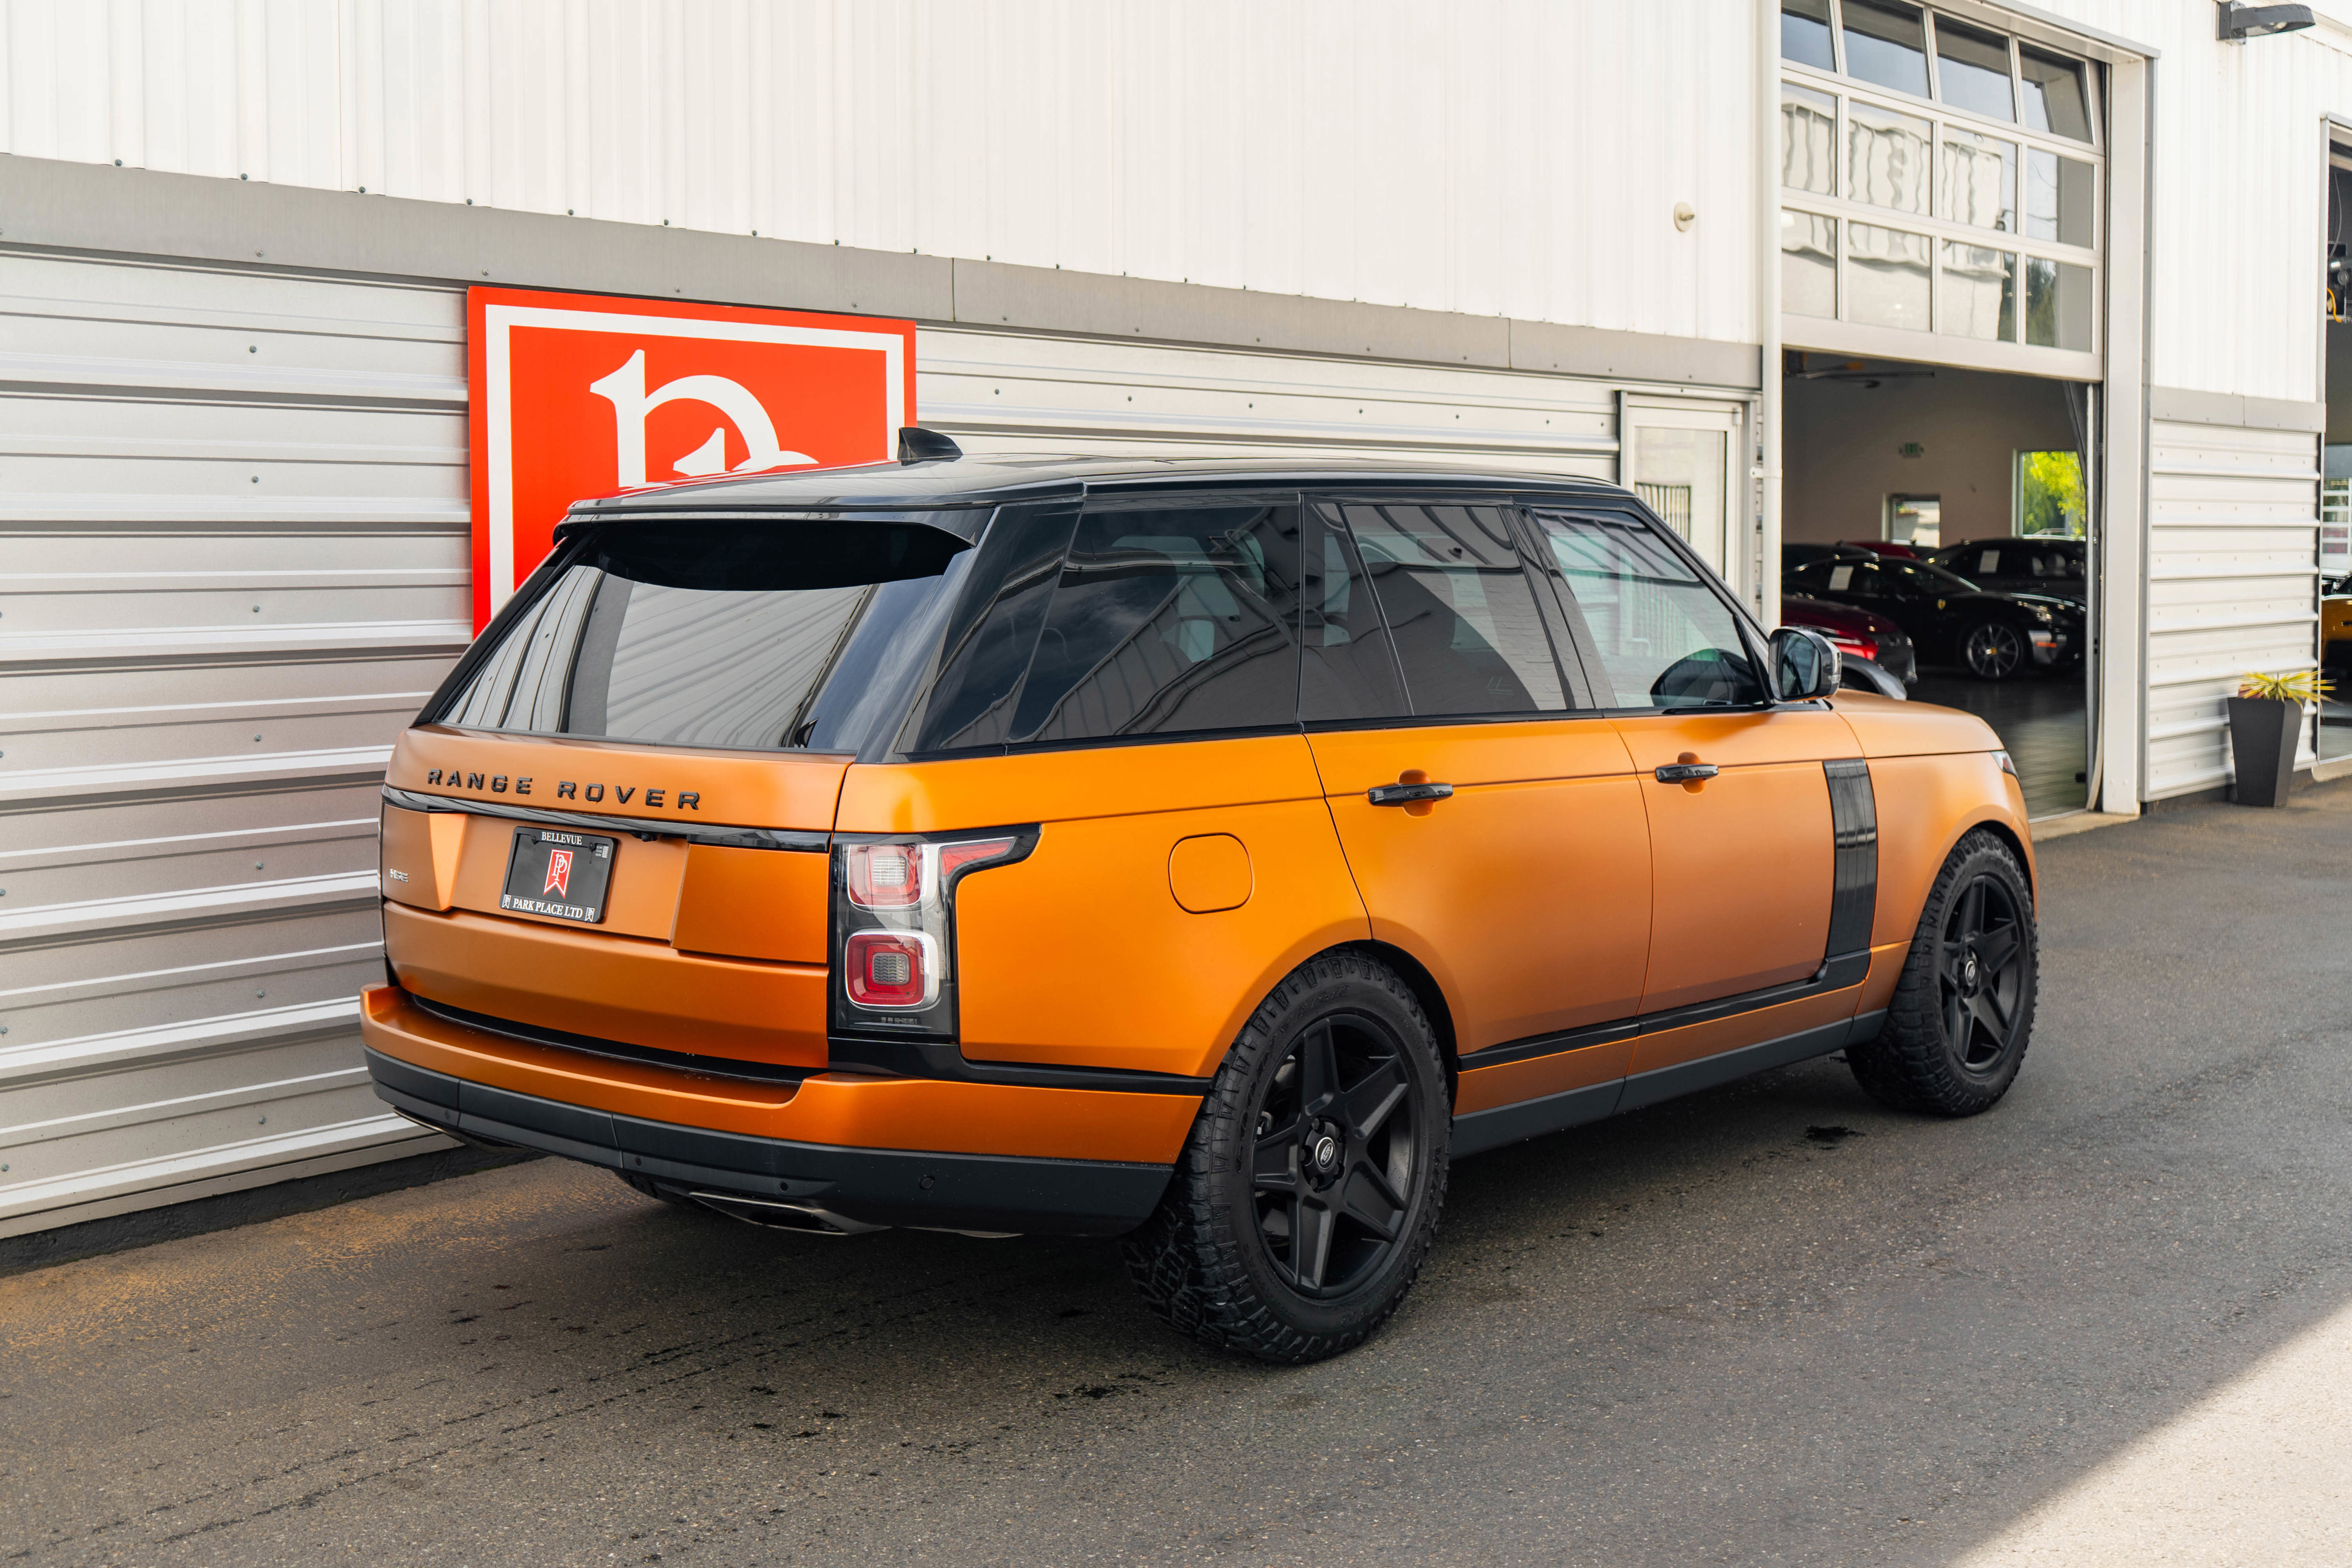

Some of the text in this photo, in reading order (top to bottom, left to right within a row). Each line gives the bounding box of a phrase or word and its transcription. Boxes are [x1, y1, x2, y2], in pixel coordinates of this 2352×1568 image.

[428, 768, 699, 810] RANGE ROVER
[541, 831, 582, 845] BELLEVUE
[513, 898, 583, 918] PARK PLACE LTD
